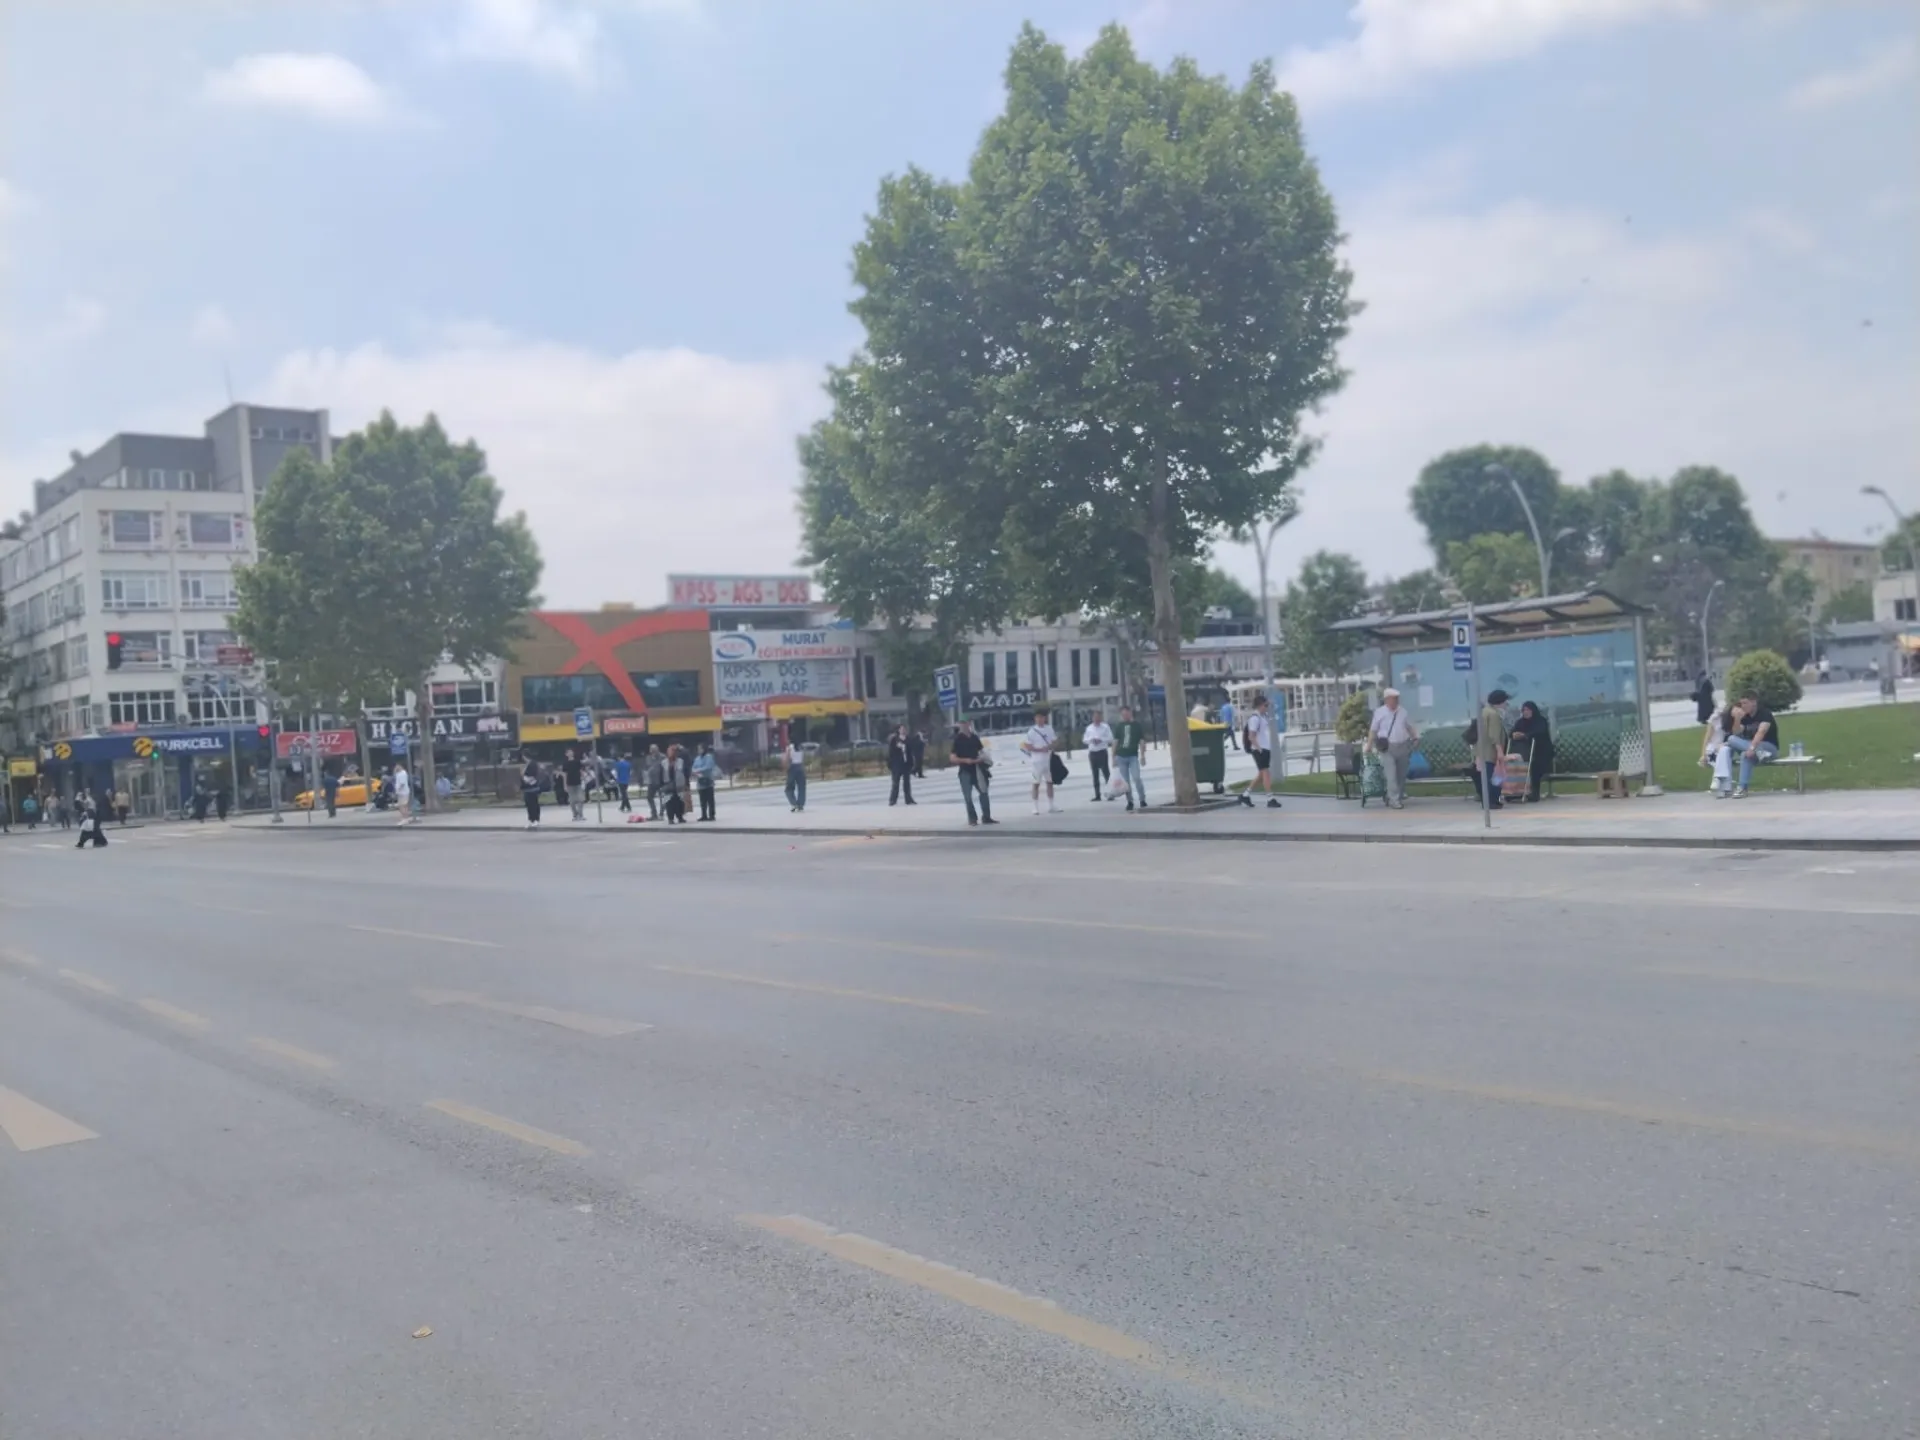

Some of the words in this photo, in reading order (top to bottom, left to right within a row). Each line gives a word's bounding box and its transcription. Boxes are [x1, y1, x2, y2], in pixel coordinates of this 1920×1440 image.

[674, 581, 717, 604] KPSS
[732, 580, 763, 603] AGS
[777, 579, 809, 603] DGS
[782, 632, 827, 645] MURAT
[723, 662, 762, 678] KPSS
[778, 661, 808, 677] DGS
[725, 680, 775, 697] SMMM
[969, 691, 1038, 709] AZADE
[154, 735, 224, 751] TURKCELL
